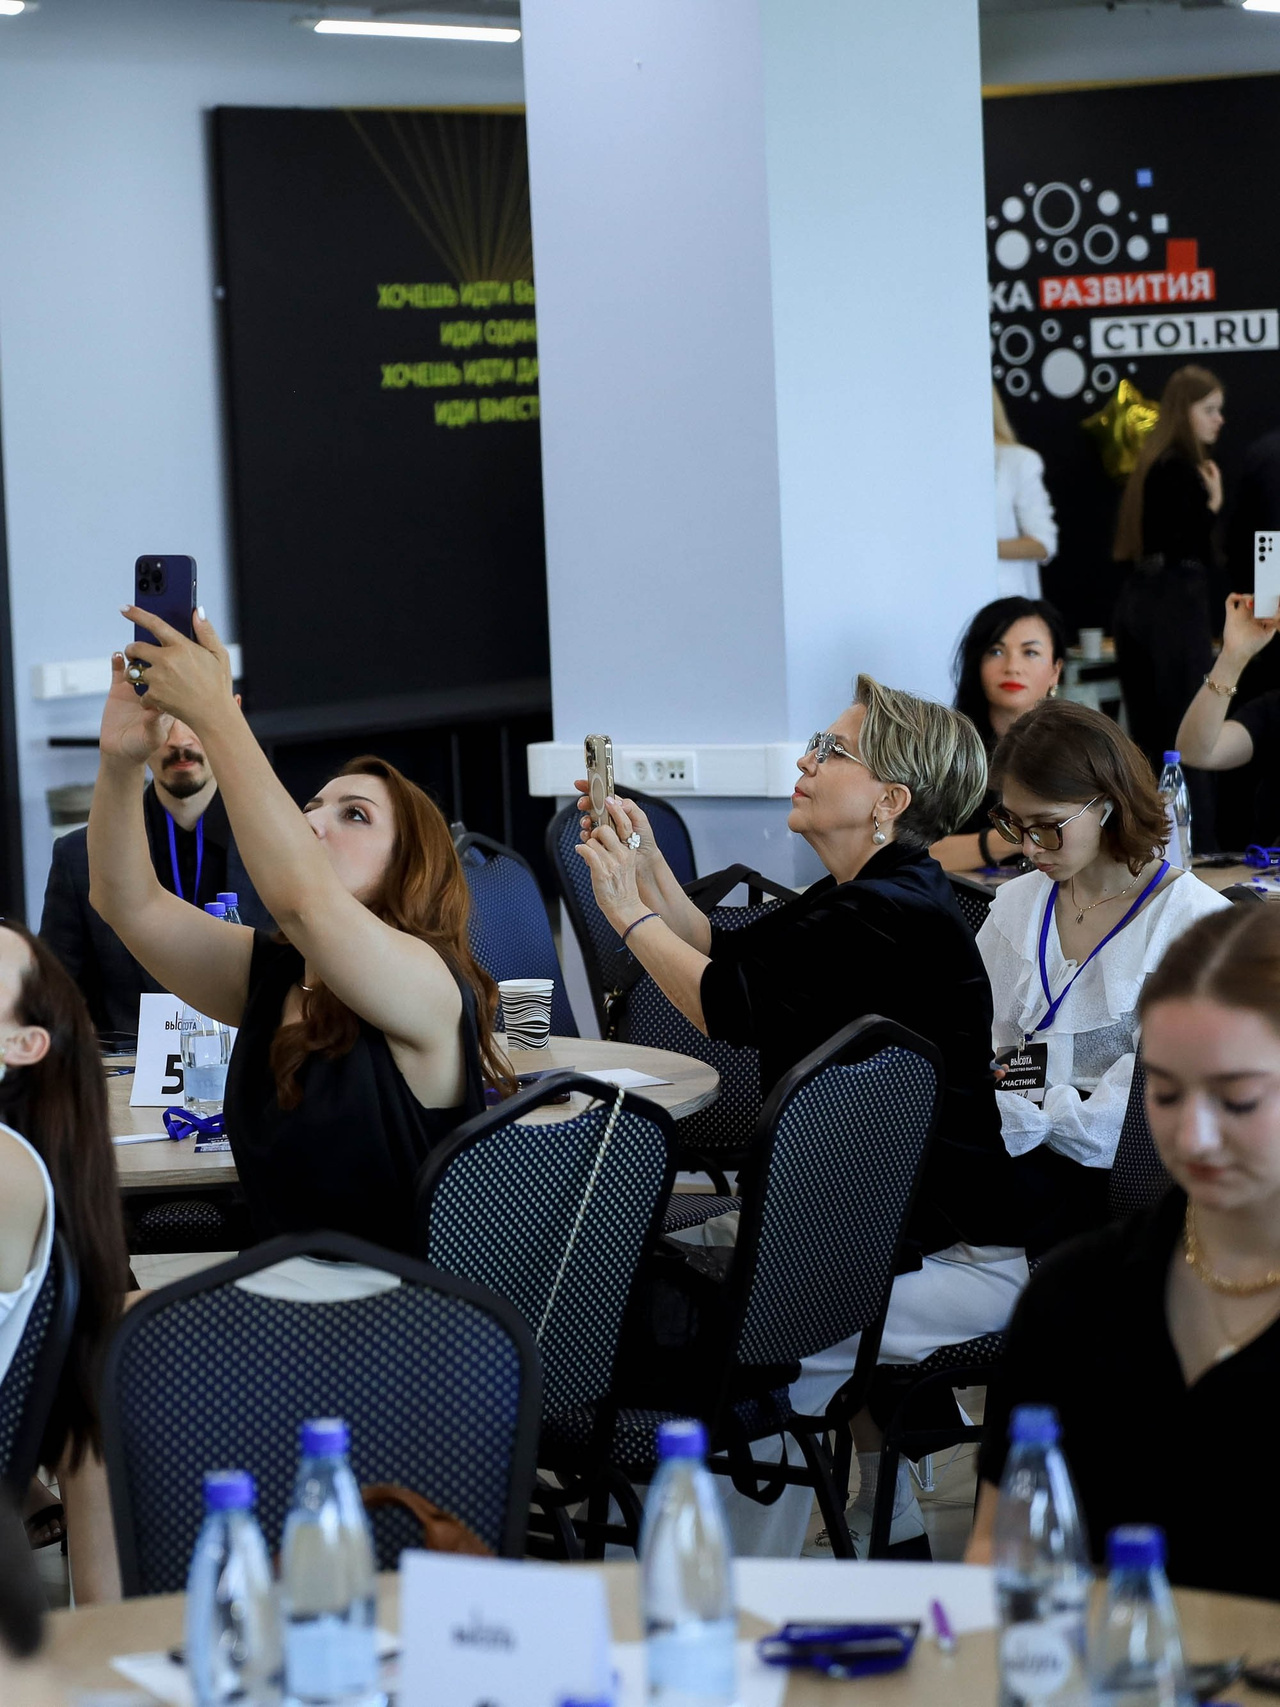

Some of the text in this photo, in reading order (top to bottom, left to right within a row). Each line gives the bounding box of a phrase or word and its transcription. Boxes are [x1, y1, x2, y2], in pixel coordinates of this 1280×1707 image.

[377, 283, 459, 309] ХОЧЕШЬ
[459, 280, 512, 309] ИДТИ
[1043, 270, 1212, 309] РАЗВИТИЯ
[439, 320, 483, 347] ИДИ
[380, 362, 463, 388] ХОЧЕШЬ
[463, 358, 515, 387] ИДТИ
[434, 400, 478, 428] ИДИ
[161, 1054, 184, 1094] 5
[1001, 1078, 1037, 1088] УЧАСТНИК
